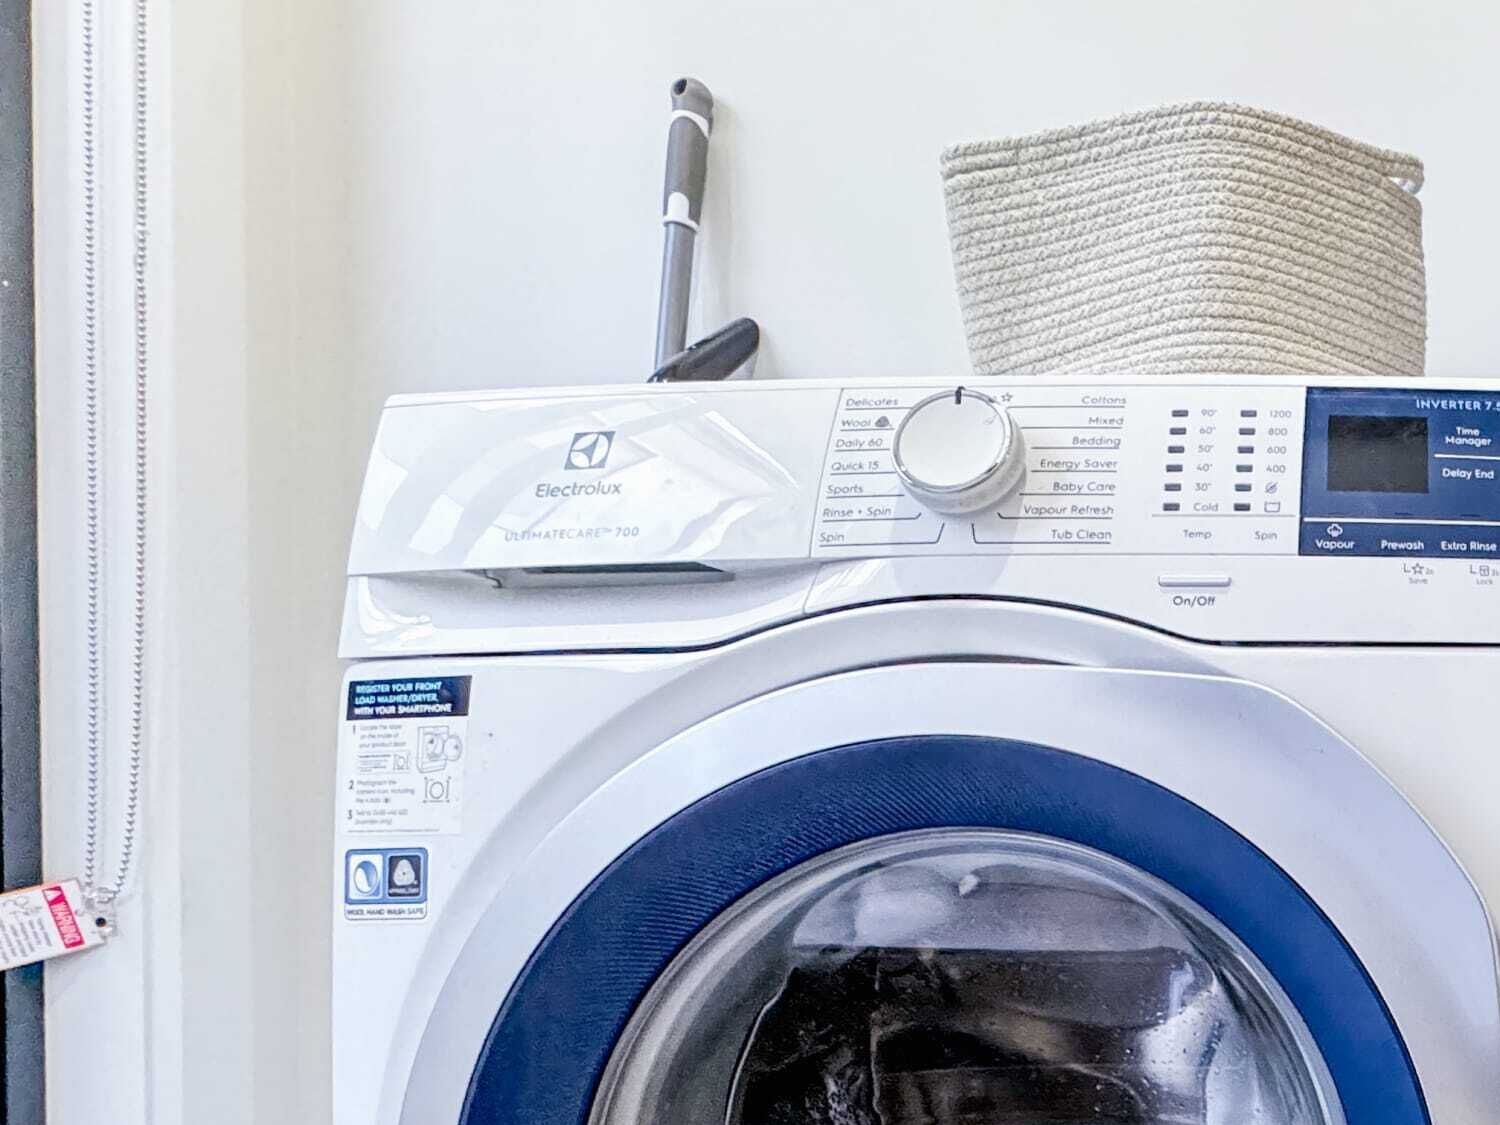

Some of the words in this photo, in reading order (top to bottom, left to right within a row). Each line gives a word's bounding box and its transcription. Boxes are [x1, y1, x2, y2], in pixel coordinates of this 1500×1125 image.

[846, 396, 899, 407] Delicates
[1081, 396, 1127, 406] Cottons
[1416, 398, 1481, 411] INVERTER
[1269, 409, 1292, 419] 1200
[841, 417, 872, 428] Wool
[1088, 416, 1124, 427] Mixed
[1268, 427, 1288, 437] 800
[1456, 427, 1480, 436] Time
[835, 437, 864, 450] Daily
[867, 438, 884, 448] 60
[1072, 436, 1121, 448] Bedding
[1445, 436, 1492, 447] Manager
[1267, 445, 1287, 455] 600
[831, 461, 863, 473] Quick
[867, 461, 880, 471] 15
[1040, 459, 1079, 472] Energy
[1083, 458, 1117, 470] Saver
[1265, 464, 1286, 474] 400
[1442, 468, 1472, 480] Delay
[1475, 469, 1495, 479] End
[535, 481, 622, 498] Electrolux
[826, 483, 864, 496] Sports
[1053, 482, 1083, 495] Baby
[1087, 482, 1116, 493] Care
[1023, 505, 1067, 518] Vapour
[1070, 504, 1114, 515] Refresh
[1193, 501, 1219, 512] Cold
[823, 506, 853, 518] Rinse
[867, 506, 892, 519] Spin
[615, 526, 640, 538] 700
[1051, 529, 1075, 540] Tub
[1077, 529, 1112, 540] Clean
[1182, 530, 1212, 542] Temp
[1255, 530, 1278, 542] Spin
[819, 532, 845, 545] Spin
[1315, 539, 1355, 551] Vapour
[1381, 539, 1424, 550] Prewash
[1440, 541, 1467, 551] Extra
[1470, 541, 1497, 552] Rinse
[1172, 595, 1216, 609] On/Off
[392, 683, 413, 693] YOUR
[415, 682, 442, 691] FRONT
[355, 695, 376, 705] LOAD
[354, 706, 374, 715] WITH
[375, 706, 396, 714] YOUR
[398, 704, 452, 713] SMARTPHONE
